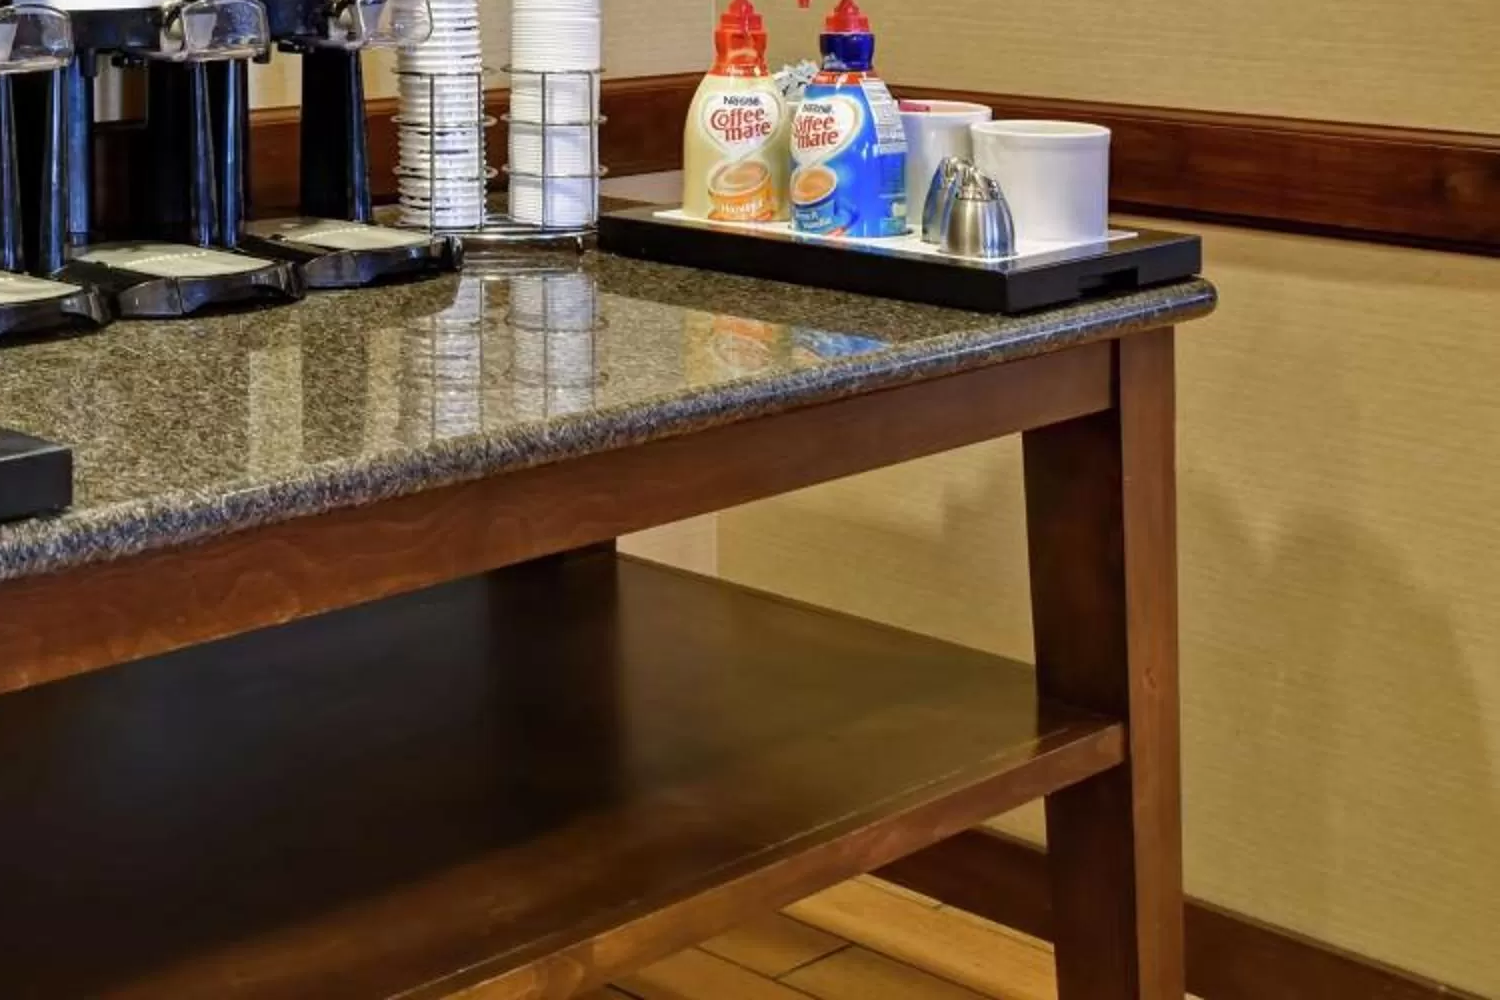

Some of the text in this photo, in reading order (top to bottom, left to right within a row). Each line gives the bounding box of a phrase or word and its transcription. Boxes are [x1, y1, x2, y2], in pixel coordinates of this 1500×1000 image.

[710, 108, 765, 131] Coffee
[725, 121, 771, 142] mate
[797, 130, 838, 149] mate
